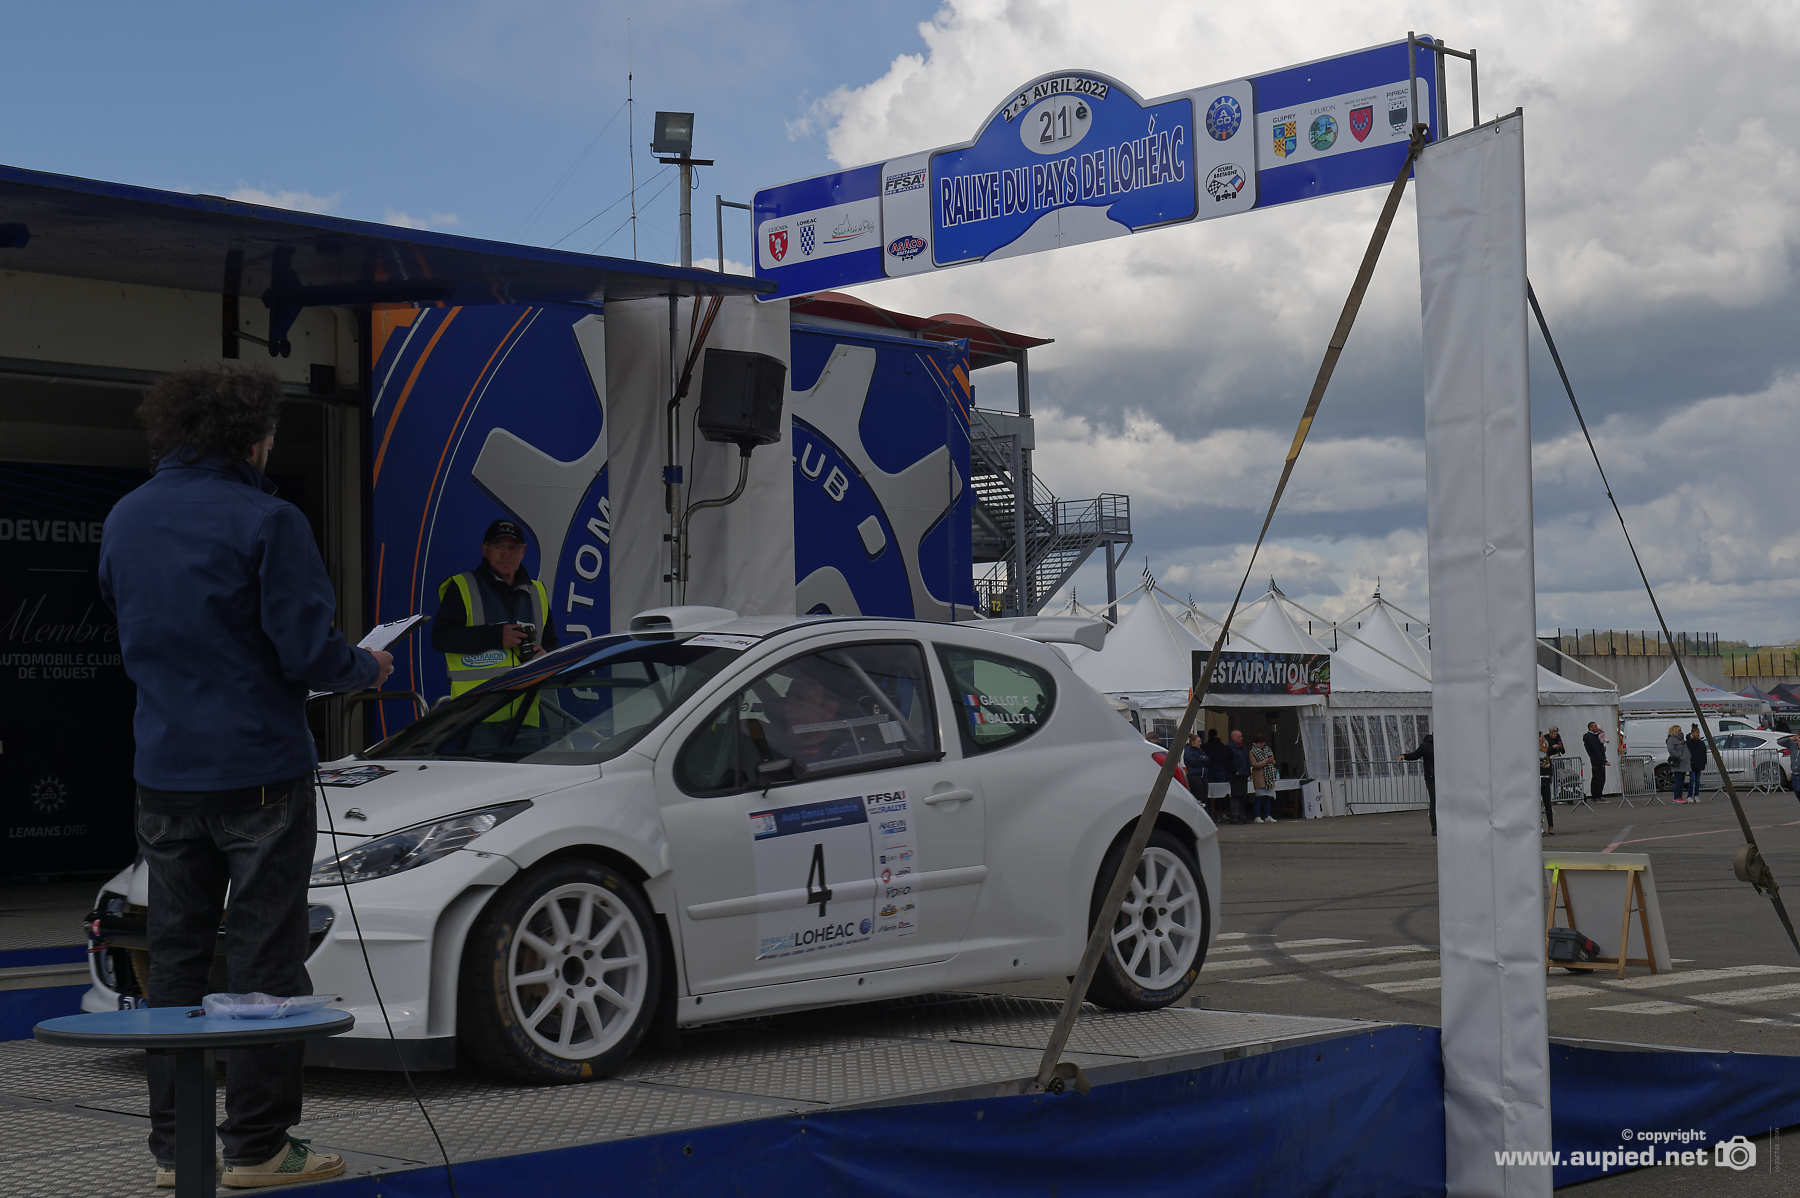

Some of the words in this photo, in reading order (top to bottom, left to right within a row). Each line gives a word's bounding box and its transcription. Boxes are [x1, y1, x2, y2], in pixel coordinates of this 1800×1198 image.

[1033, 79, 1073, 100] AVRIL
[1076, 78, 1107, 98] 2022
[886, 173, 923, 191] FFSA
[940, 171, 1000, 228] RALLYE
[1003, 166, 1030, 217] DU
[1033, 154, 1078, 210] PAYS
[1081, 149, 1106, 200] DE
[1109, 114, 1185, 195] LOHÉAC
[792, 442, 849, 502] UB
[0, 652, 84, 666] UTOMOBILE
[87, 652, 121, 666] CLUB
[18, 666, 38, 680] DE
[43, 666, 97, 680] L'OUEST
[867, 790, 906, 805] FFSA
[807, 843, 832, 918] 4
[794, 922, 855, 947] LOHÉAC
